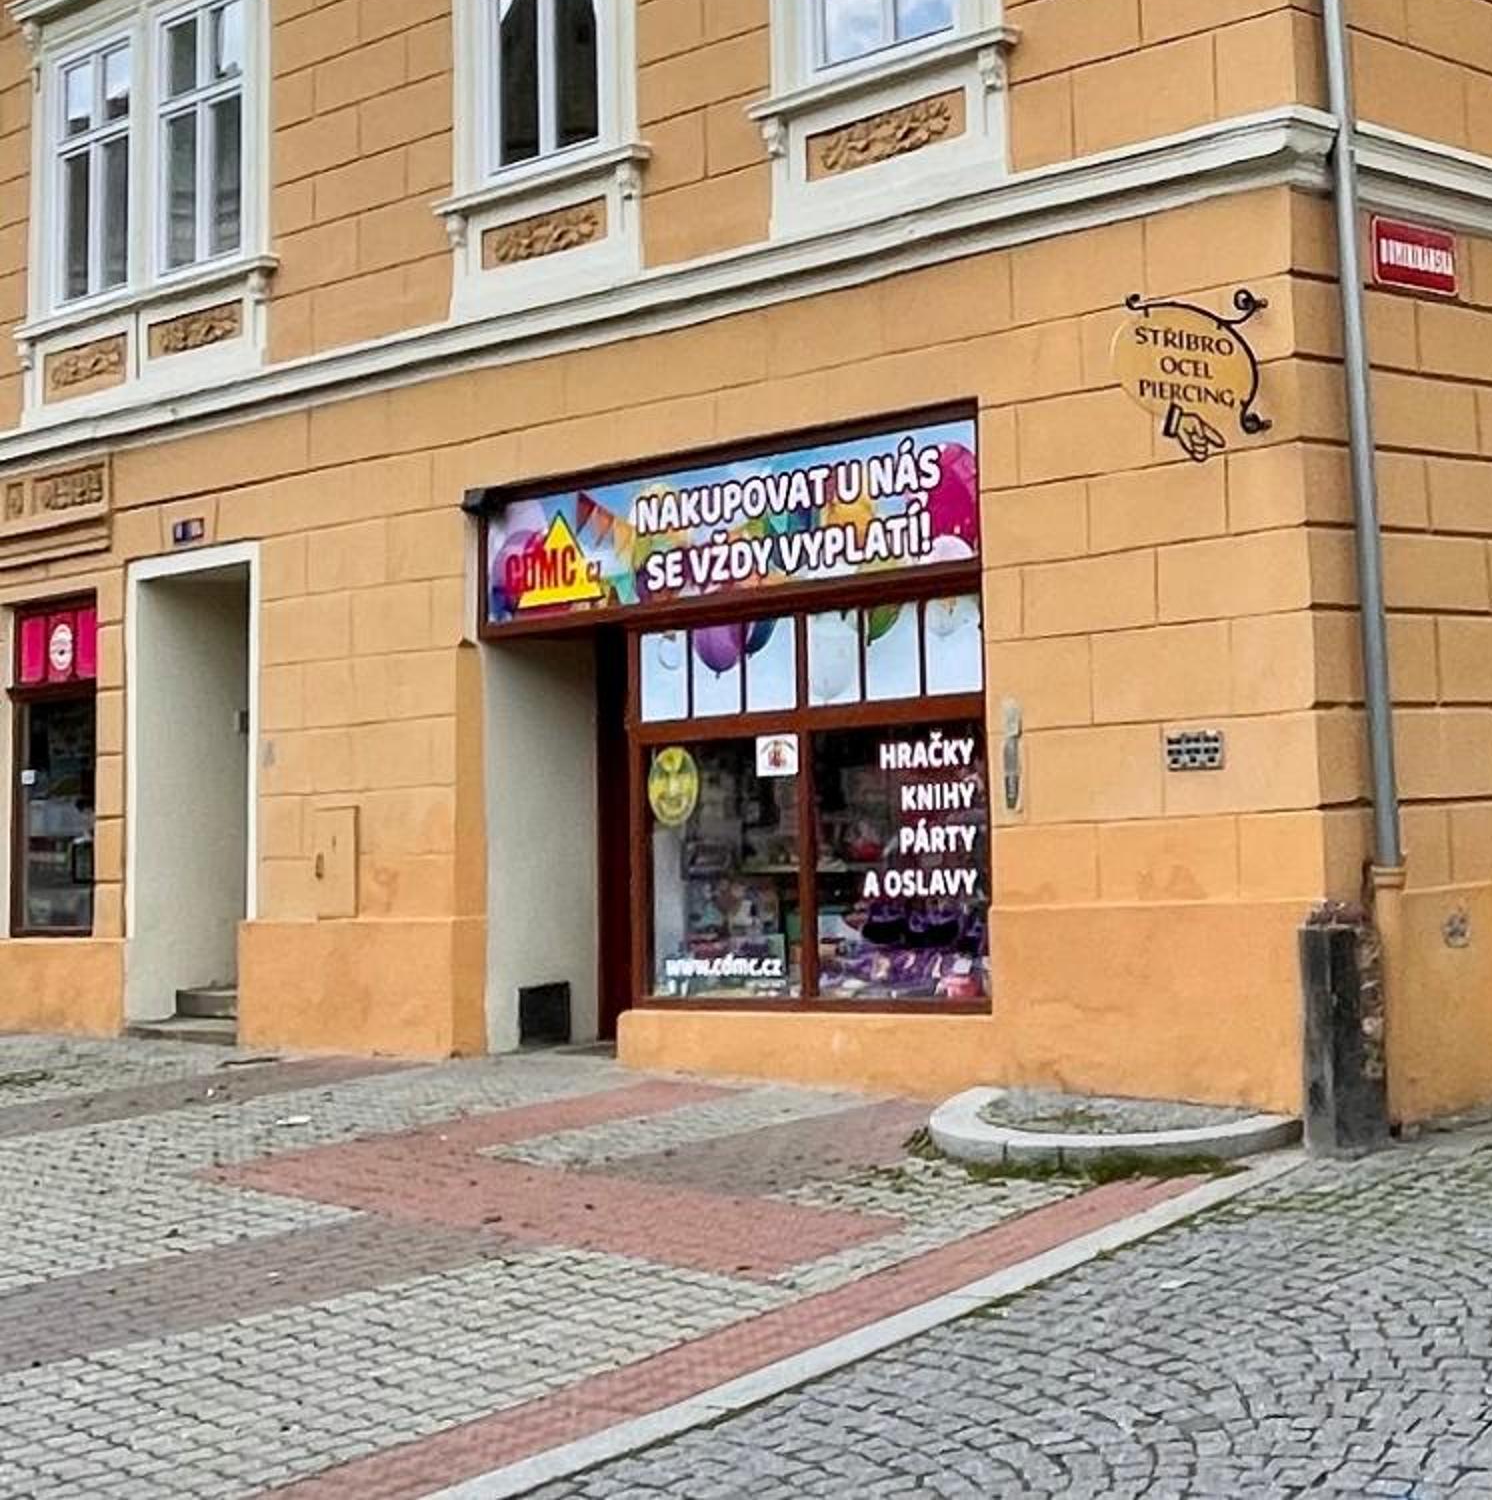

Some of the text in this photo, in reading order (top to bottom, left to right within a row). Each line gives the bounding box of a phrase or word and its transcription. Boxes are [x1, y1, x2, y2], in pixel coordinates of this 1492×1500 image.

[1160, 355, 1214, 380] OCEL
[1139, 379, 1235, 409] PIERCING
[637, 438, 941, 534] NAKUPOVAT U NÁS
[646, 500, 931, 591] SE VŽDY VYPLATÍ!
[880, 731, 974, 769] HRAČKY
[901, 782, 975, 811] KNIHY
[900, 817, 977, 854] PÁRTY
[863, 868, 978, 898] A OSLAVY
